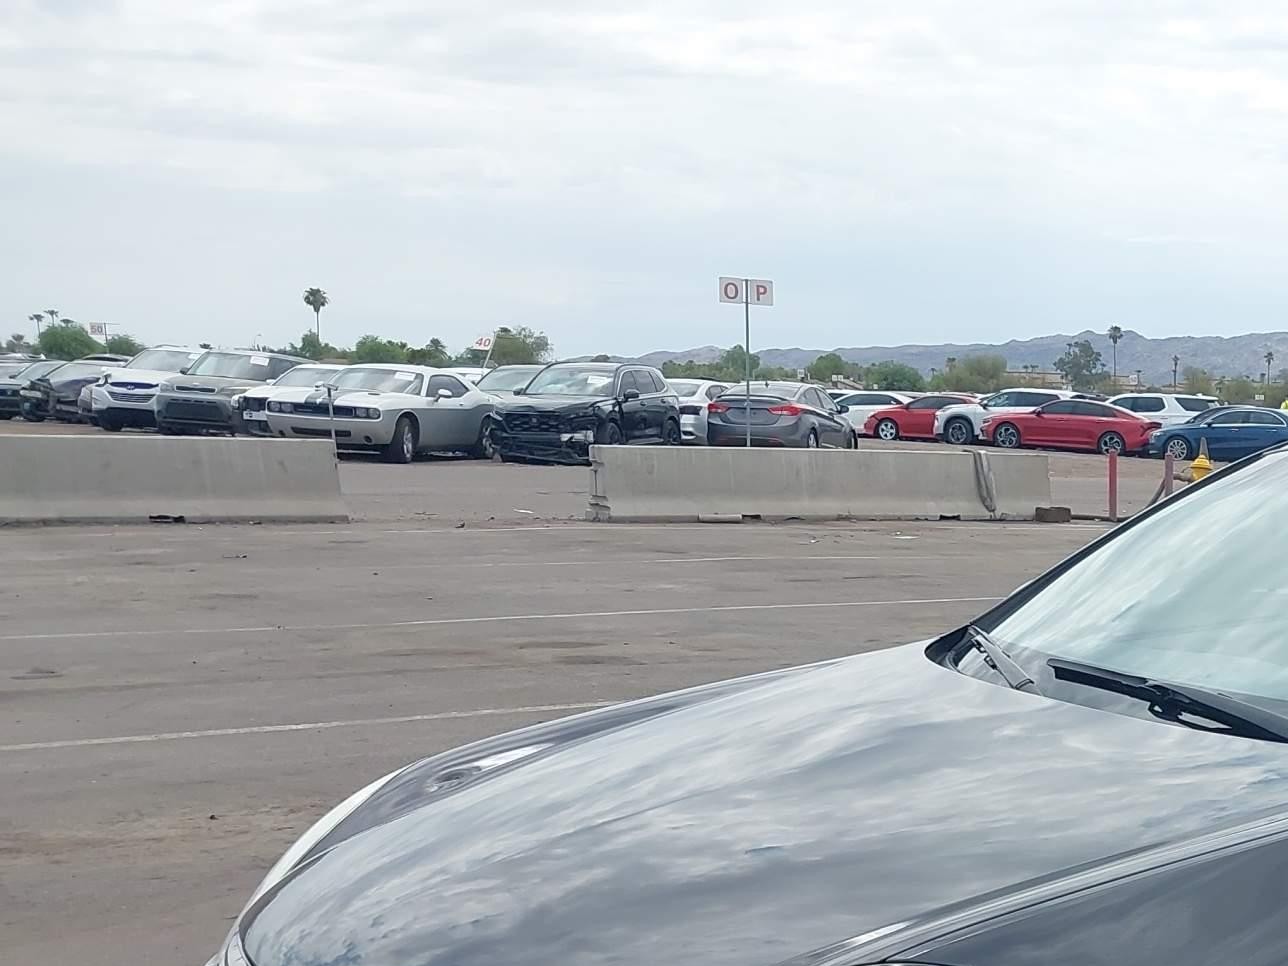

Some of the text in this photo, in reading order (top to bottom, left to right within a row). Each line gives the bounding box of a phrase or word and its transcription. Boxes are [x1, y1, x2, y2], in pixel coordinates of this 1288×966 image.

[723, 282, 739, 300] O
[756, 284, 768, 302] P
[475, 337, 491, 347] 40
